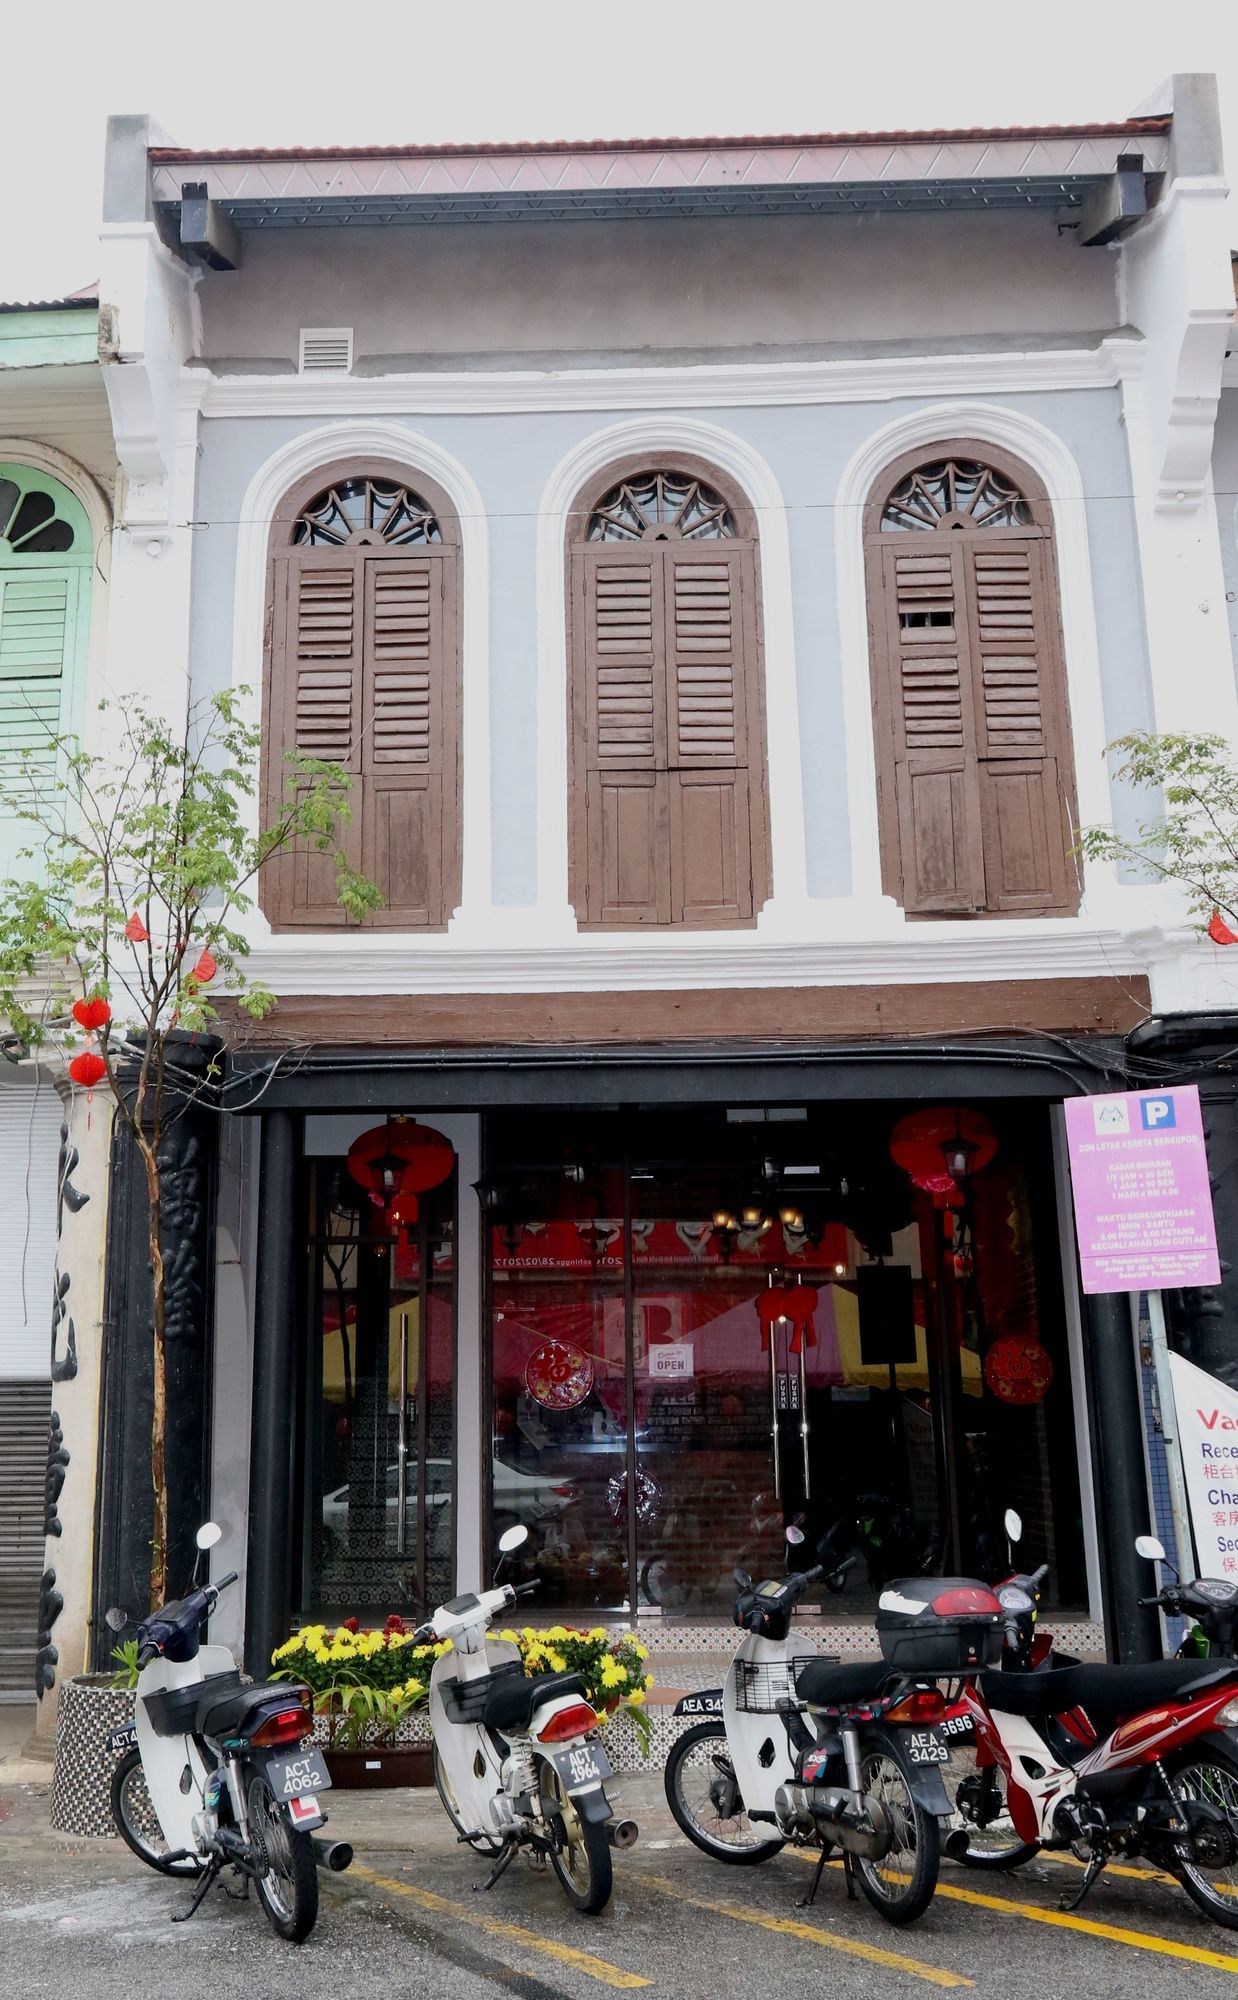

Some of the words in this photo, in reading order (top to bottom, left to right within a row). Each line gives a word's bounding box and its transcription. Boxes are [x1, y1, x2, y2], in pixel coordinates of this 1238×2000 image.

[1146, 1101, 1168, 1125] P
[1079, 1143, 1095, 1153] ZON
[1096, 1141, 1121, 1152] LETAK
[1122, 1138, 1153, 1149] KERETA
[1154, 1134, 1198, 1146] BERKUPON
[1108, 1162, 1136, 1172] KADAR
[1119, 1171, 1137, 1181] JAM
[1120, 1181, 1138, 1190] JAM
[1118, 1190, 1139, 1200] HARI
[1096, 1213, 1126, 1223] WAKTU
[1127, 1208, 1195, 1221] BERKUATKUASA
[1146, 1219, 1175, 1229] SABTU
[1118, 1230, 1137, 1240] PAGI
[1161, 1226, 1195, 1237] PETANG
[1091, 1240, 1127, 1250] KECUALI
[1128, 1239, 1152, 1248] AHAD
[1153, 1237, 1172, 1246] DAN
[1172, 1236, 1192, 1245] CUTI
[657, 1360, 685, 1370] OPEN
[1196, 1409, 1238, 1430] Va
[1201, 1443, 1238, 1458] Rece
[1203, 1463, 1238, 1480] 柜台
[682, 1698, 704, 1712] AEA
[111, 1731, 130, 1748] ACT
[910, 1732, 939, 1748] AEA
[570, 1748, 592, 1767] ACT
[909, 1747, 949, 1763] 3429
[285, 1758, 311, 1779] ACT
[570, 1763, 600, 1784] 1964
[283, 1771, 322, 1794] 4062
[291, 1798, 316, 1818] L
